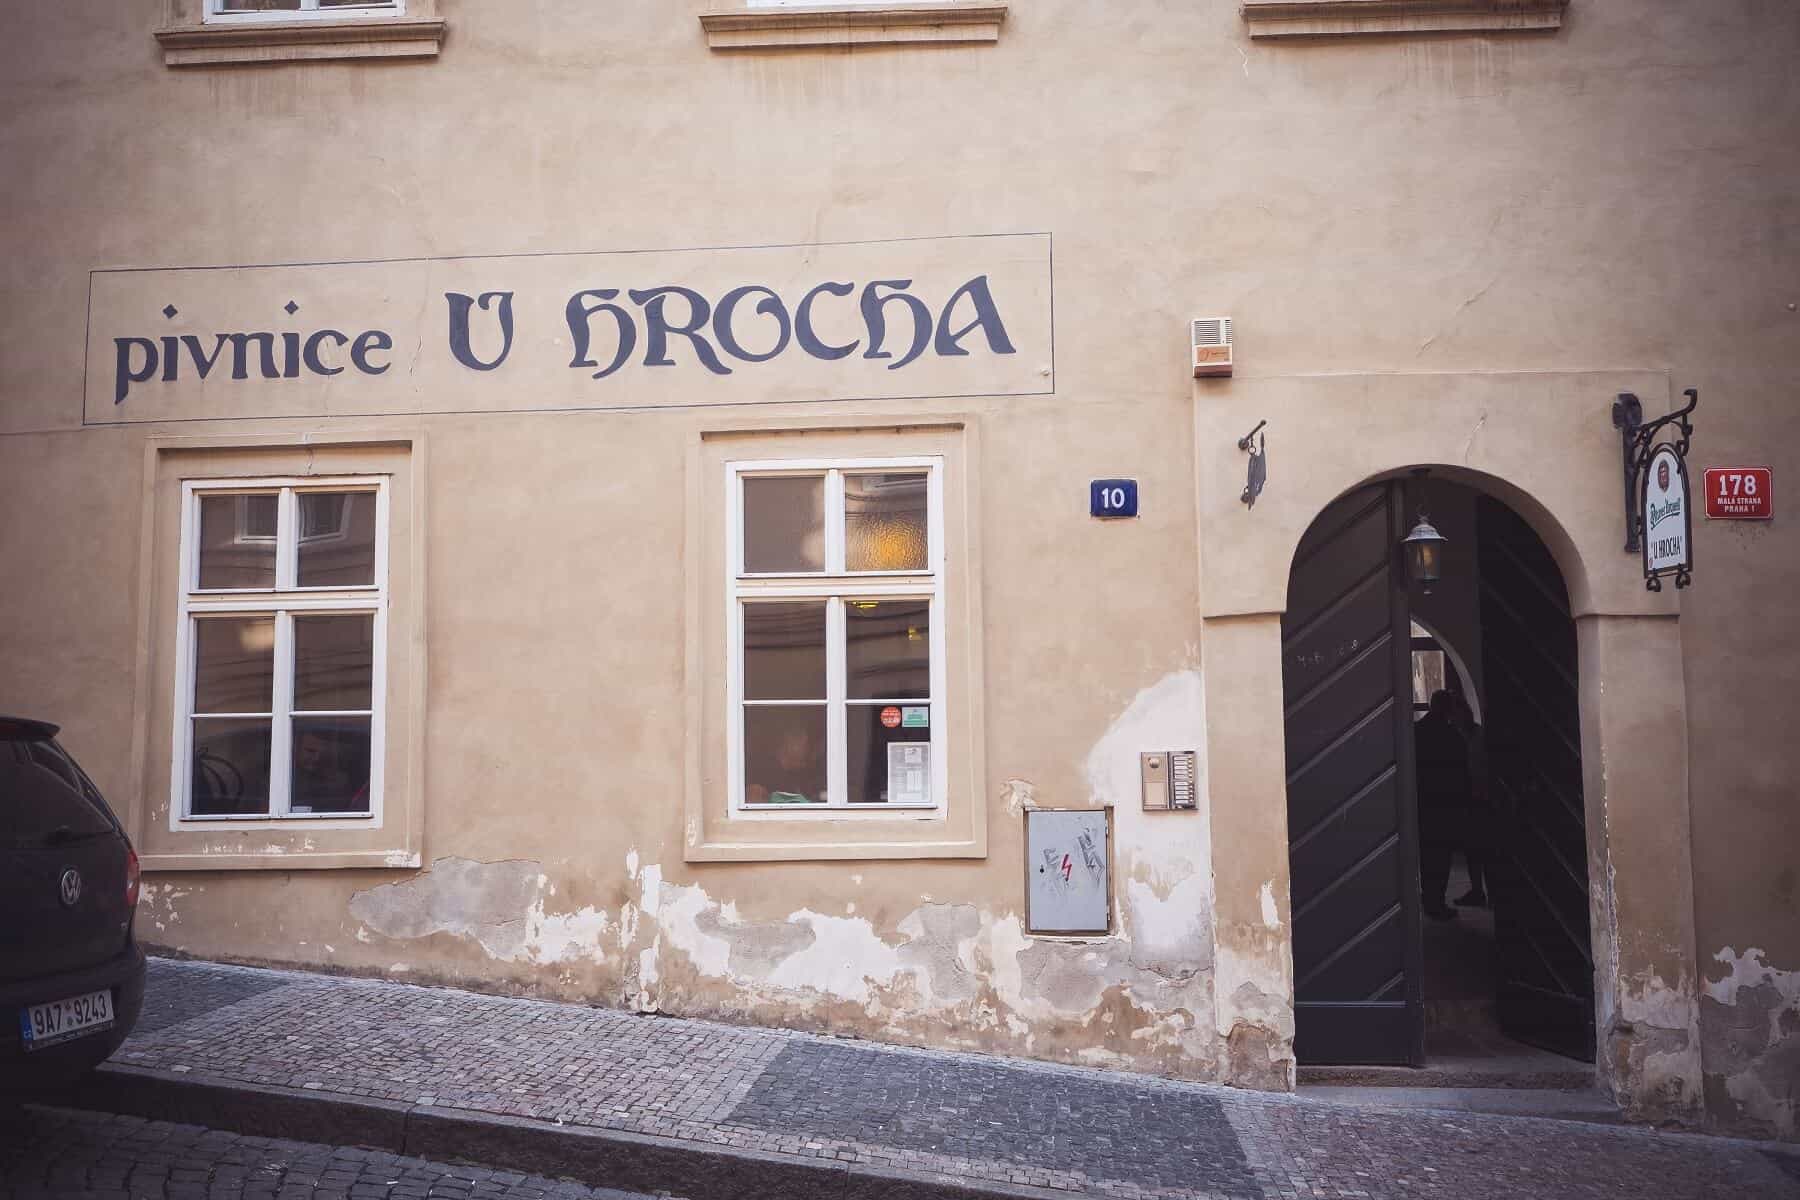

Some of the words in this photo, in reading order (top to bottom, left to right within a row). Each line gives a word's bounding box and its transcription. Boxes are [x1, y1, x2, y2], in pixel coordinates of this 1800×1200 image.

[113, 300, 393, 406] pivnice
[444, 291, 515, 371] U
[565, 275, 1017, 380] HROCHA
[1719, 474, 1757, 496] 178
[1101, 487, 1126, 509] 10
[1724, 505, 1749, 513] PRAHA
[1736, 497, 1762, 505] STRANA
[73, 993, 107, 1025] 9243
